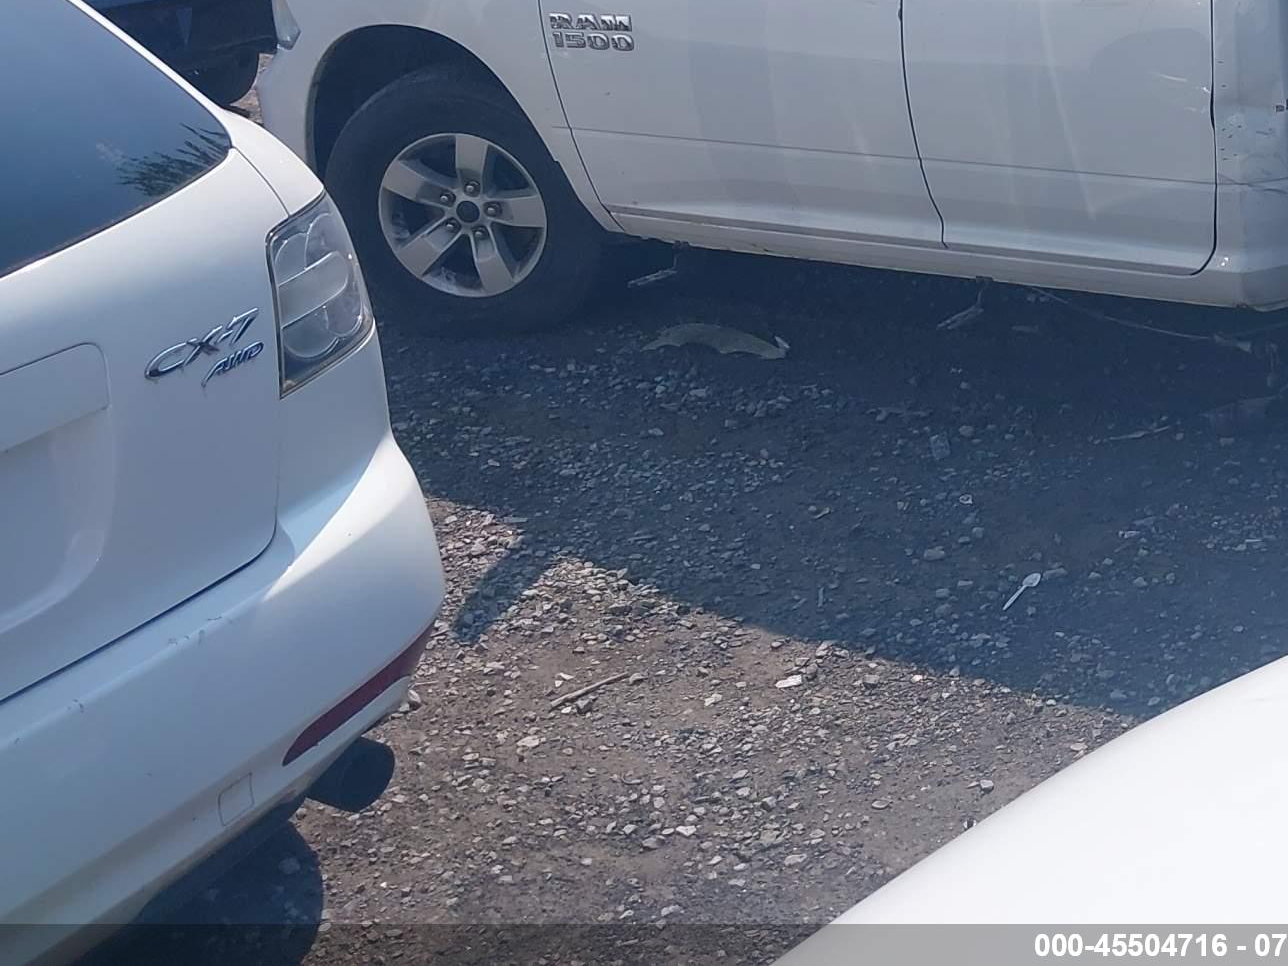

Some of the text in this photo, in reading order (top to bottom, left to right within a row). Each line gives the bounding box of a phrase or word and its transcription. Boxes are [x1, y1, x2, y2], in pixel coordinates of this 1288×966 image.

[549, 12, 632, 32] RAM
[552, 31, 634, 51] 1500
[145, 307, 259, 378] CX-7
[201, 340, 264, 388] AWD
